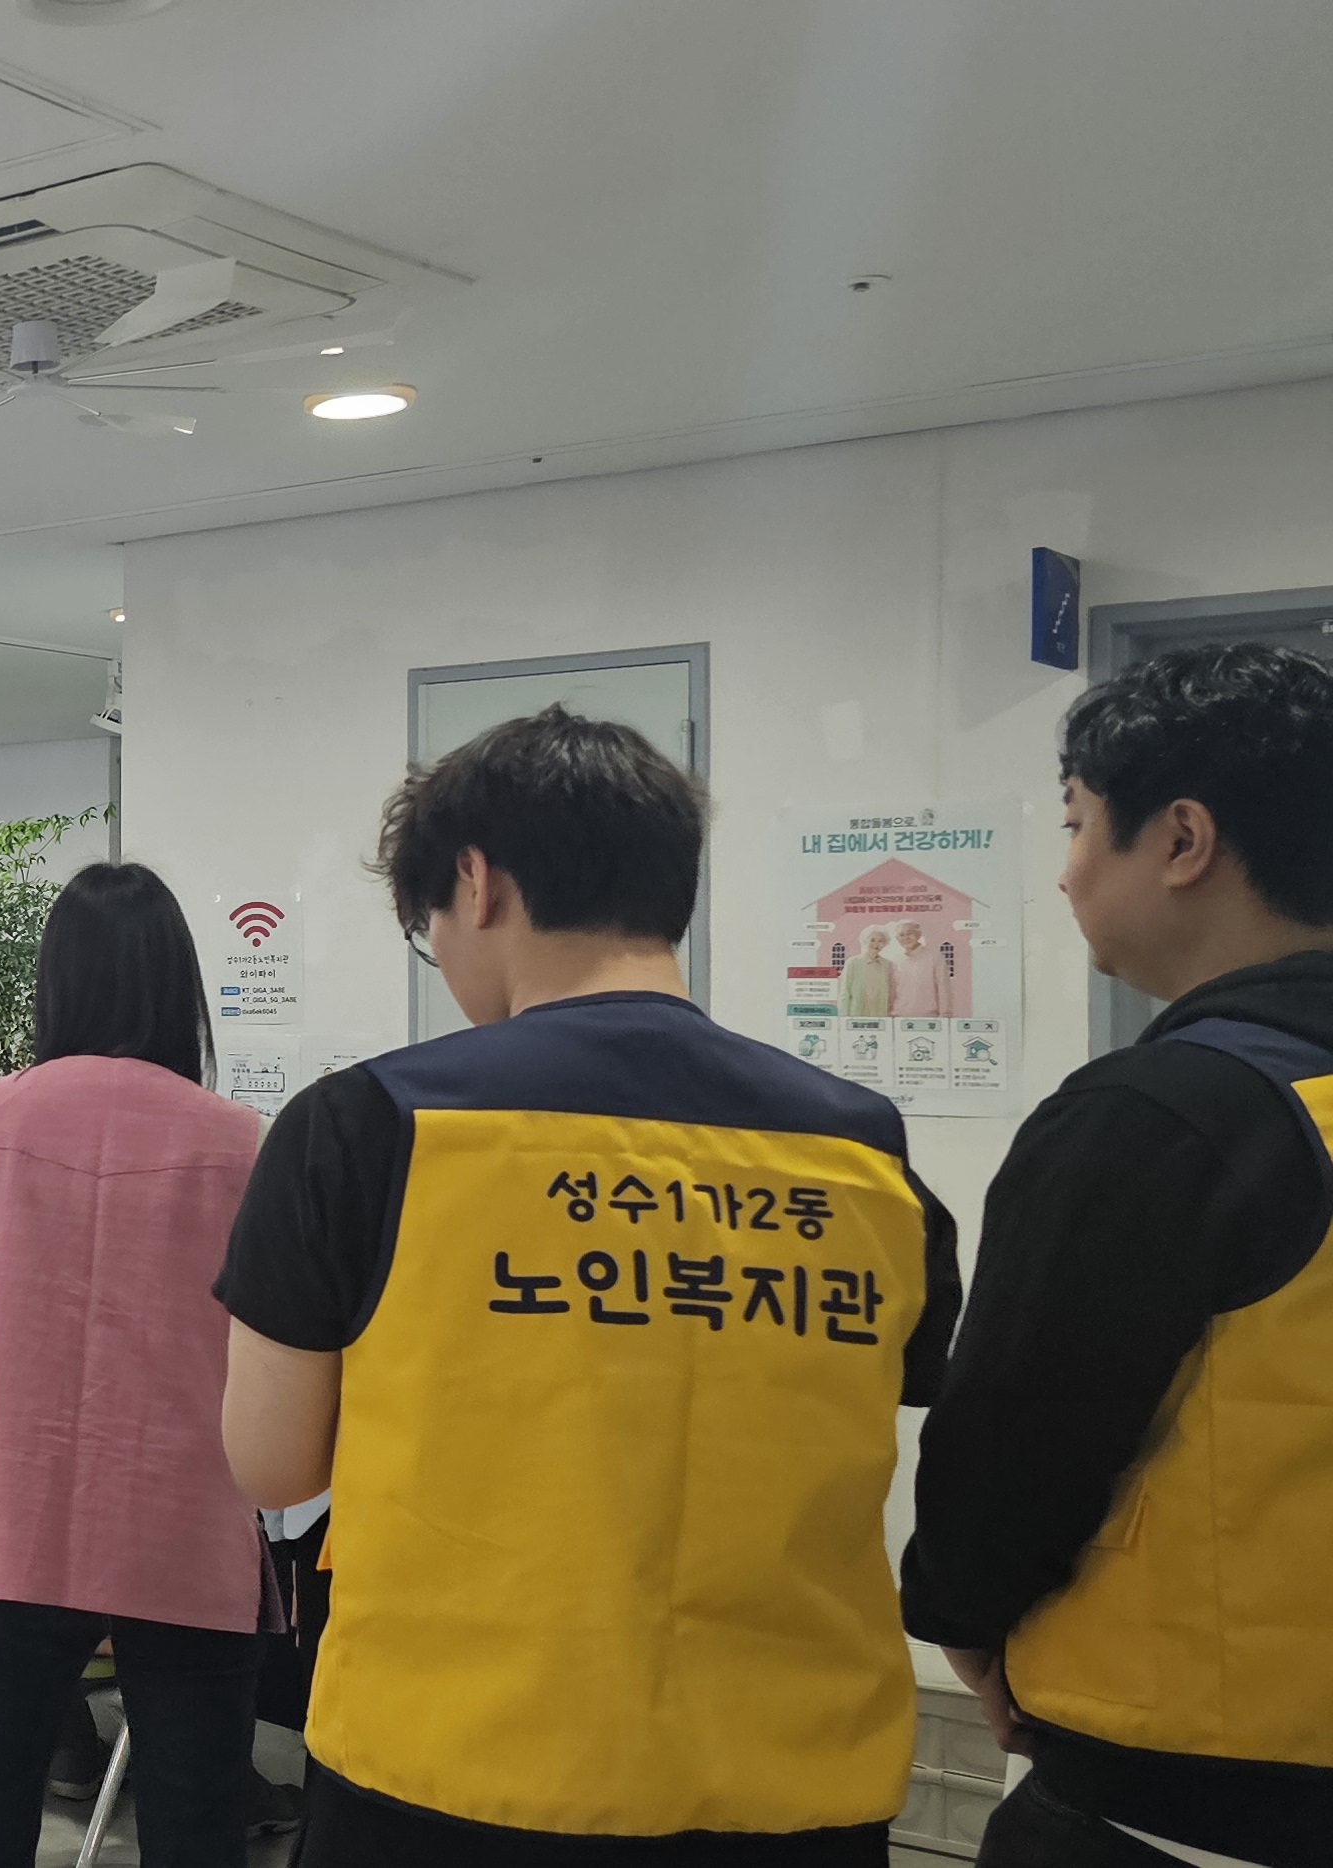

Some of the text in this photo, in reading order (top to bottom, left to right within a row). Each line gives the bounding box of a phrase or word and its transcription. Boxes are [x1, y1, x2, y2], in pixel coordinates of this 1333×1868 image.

[801, 829, 994, 853] 내 집에서 건강하게!
[240, 969, 276, 978] 와이파이
[546, 1170, 834, 1241] 성수1가2동
[488, 1248, 884, 1347] 노인복지관
